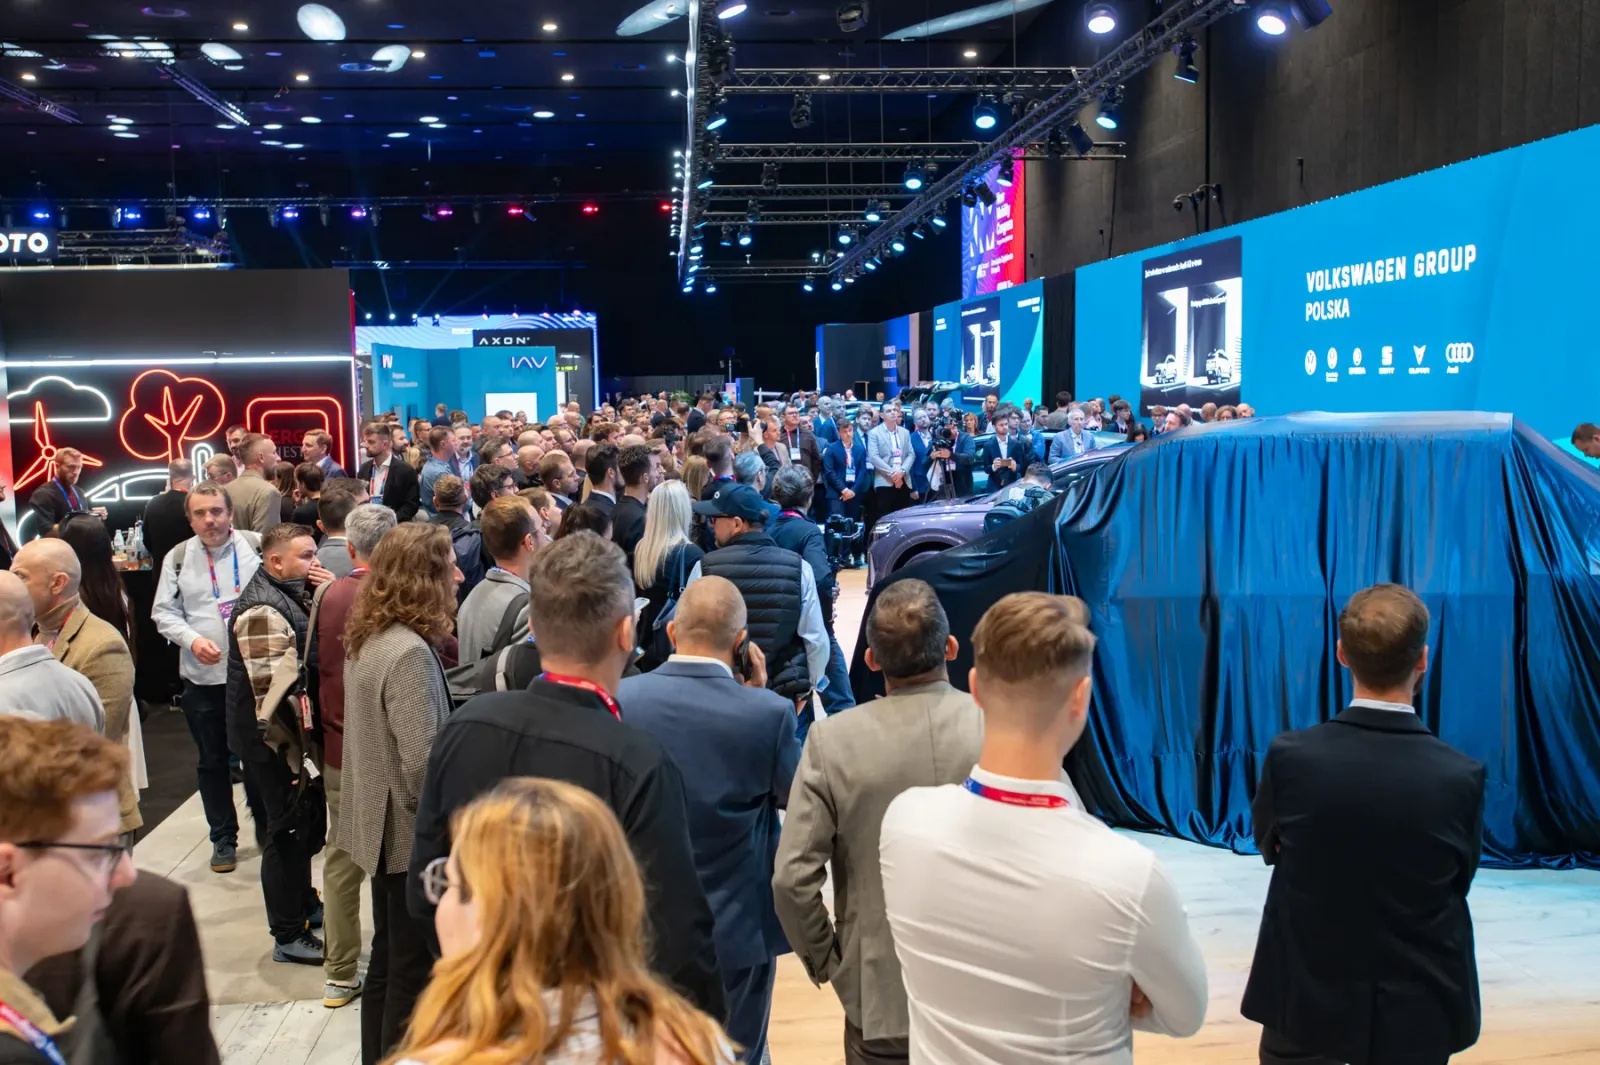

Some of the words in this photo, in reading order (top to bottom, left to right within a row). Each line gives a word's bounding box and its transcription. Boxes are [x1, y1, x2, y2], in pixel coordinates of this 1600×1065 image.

[1306, 256, 1407, 293] VOLKSWAGEN
[1414, 244, 1477, 278] GROUP
[1305, 298, 1350, 322] POLSKA
[511, 356, 548, 369] IAV
[270, 428, 305, 445] ERG
